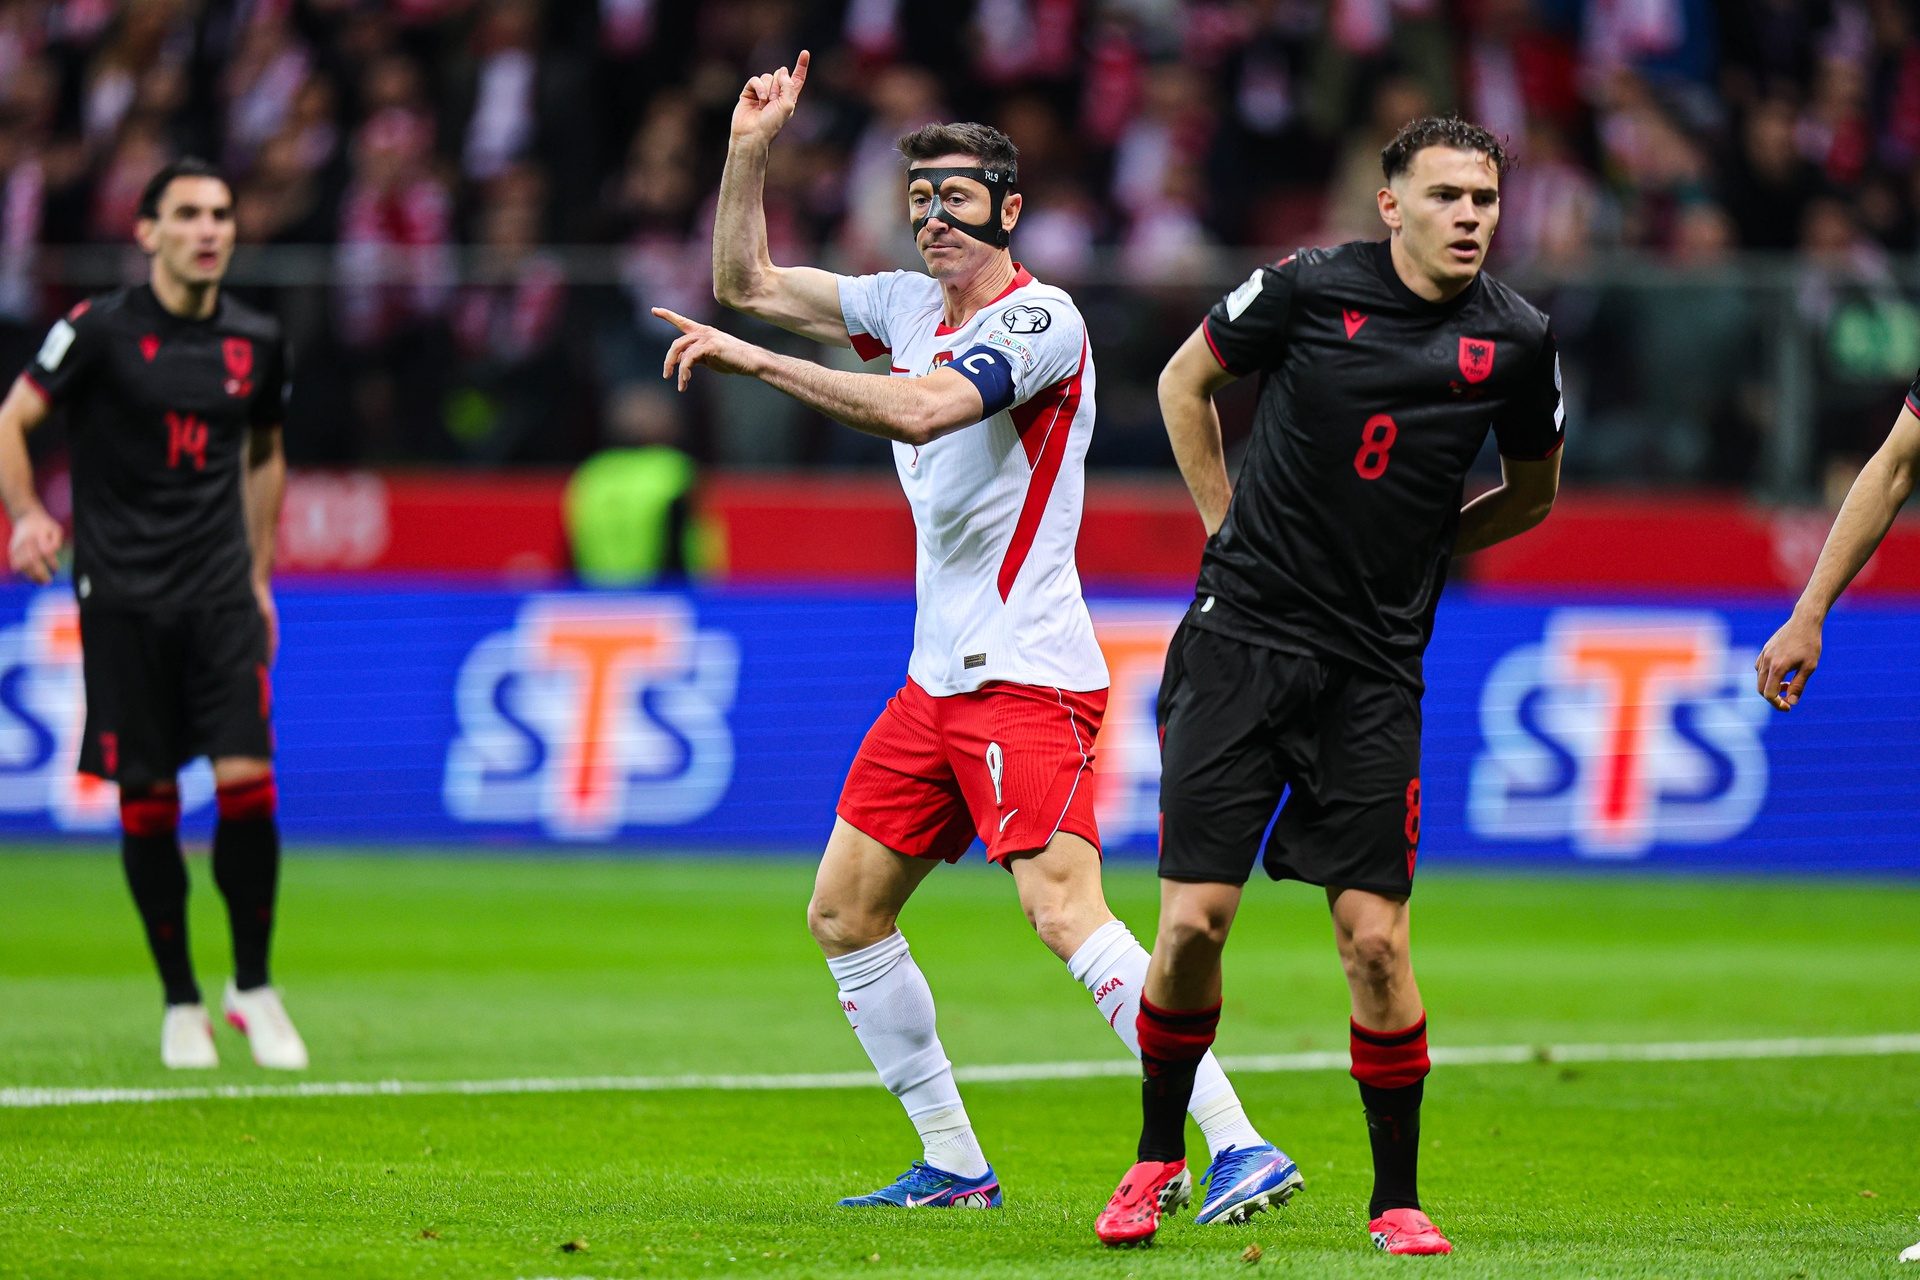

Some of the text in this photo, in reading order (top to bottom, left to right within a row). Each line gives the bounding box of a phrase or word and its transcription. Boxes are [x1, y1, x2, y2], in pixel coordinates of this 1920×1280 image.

[985, 170, 999, 182] RL9
[962, 353, 996, 375] C
[164, 410, 208, 471] 14
[1353, 413, 1398, 480] 8
[446, 596, 740, 838] STS
[1470, 608, 1768, 858] STS
[986, 741, 1004, 805] 9
[1404, 777, 1421, 845] 8
[1093, 977, 1124, 1005] LSKA
